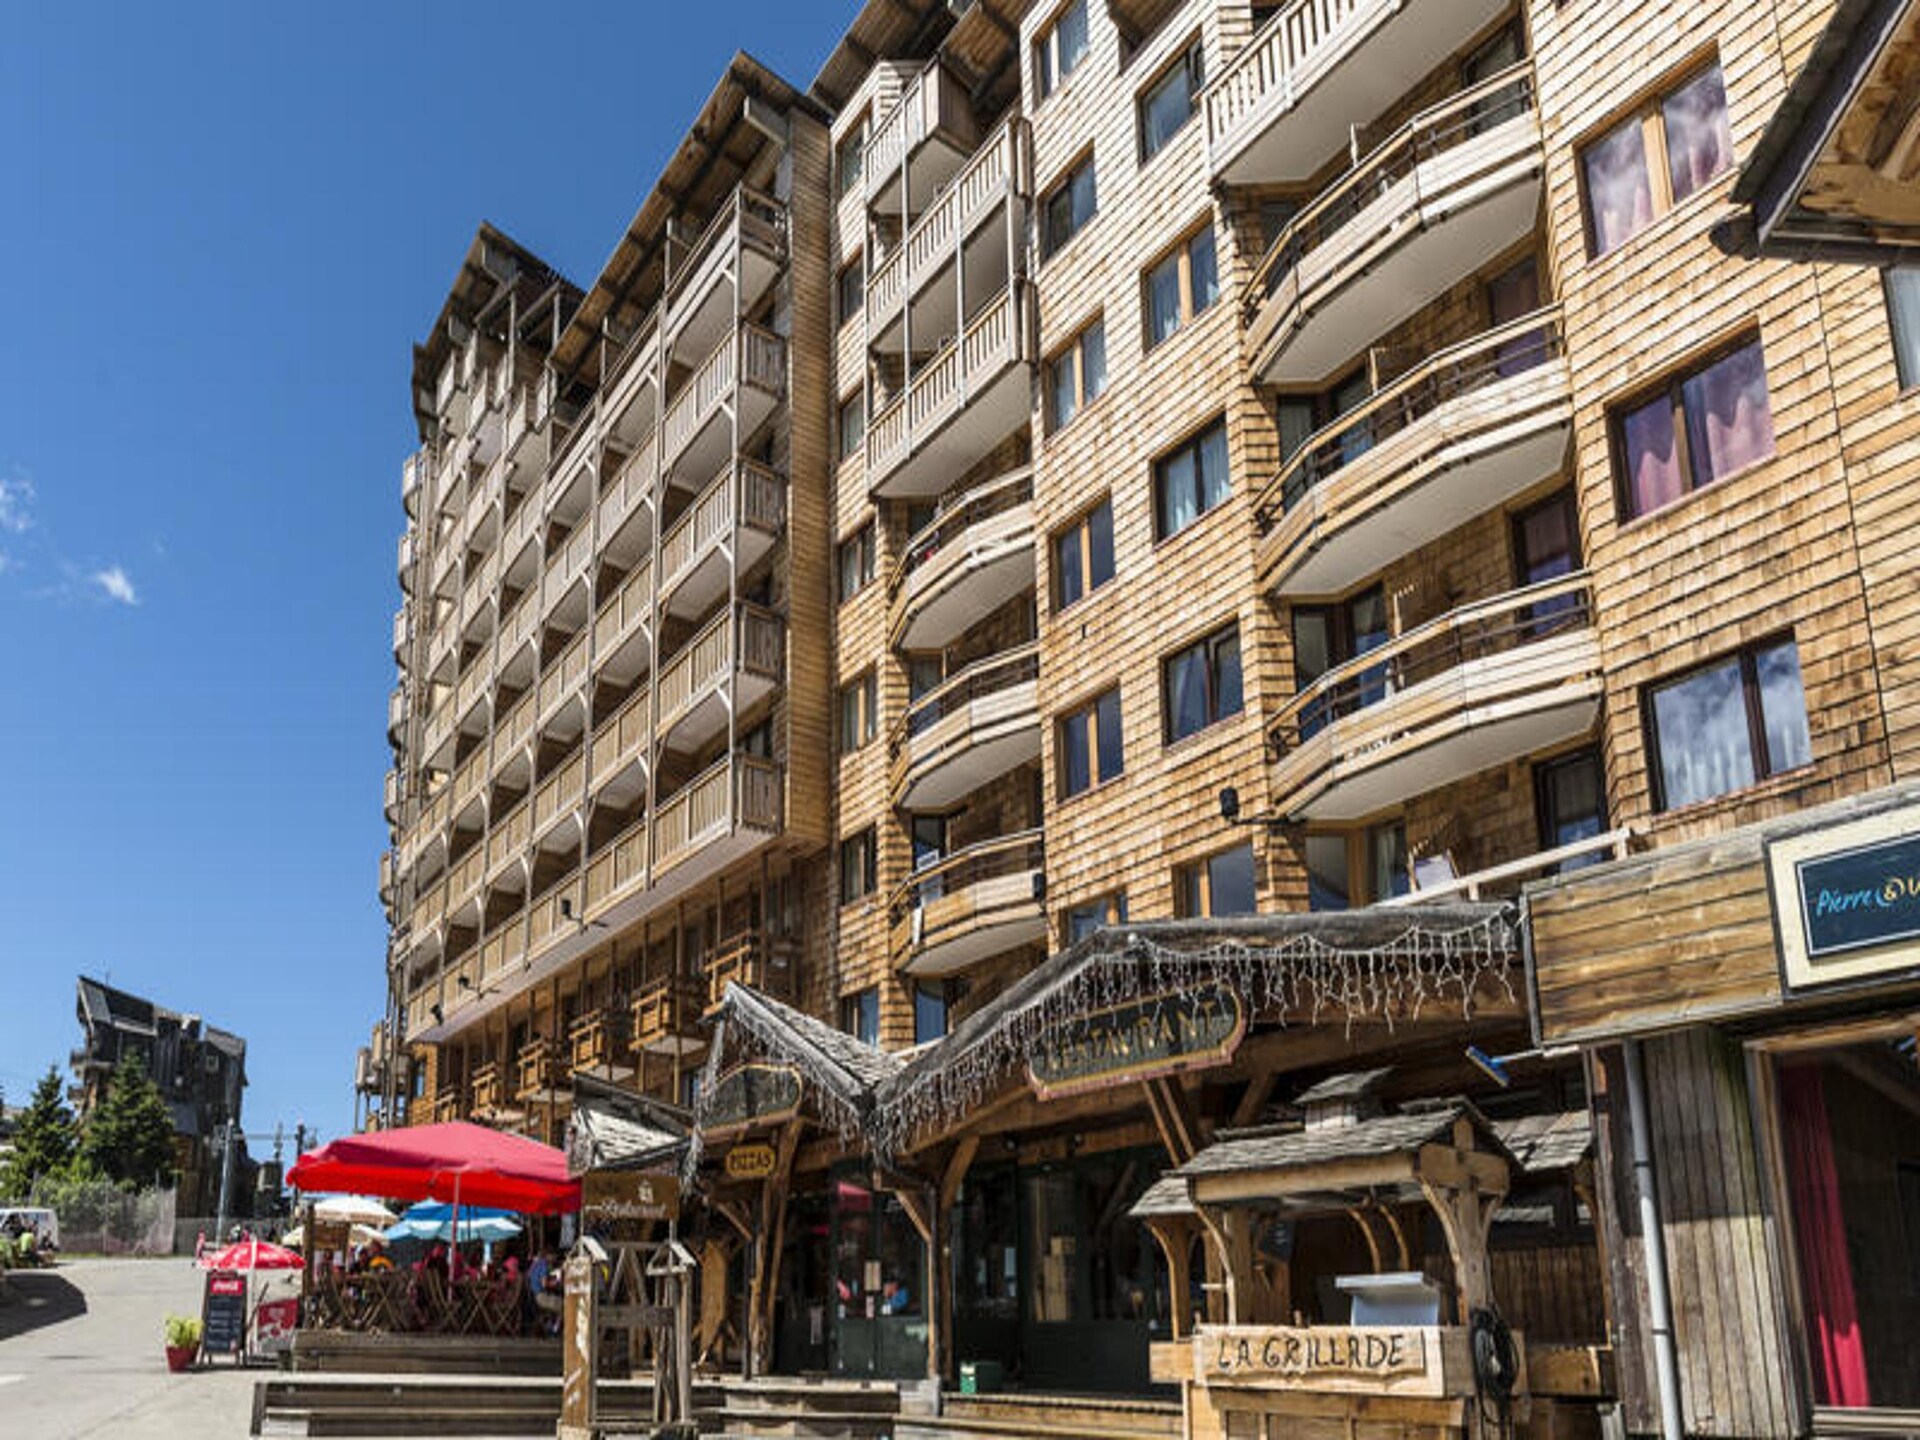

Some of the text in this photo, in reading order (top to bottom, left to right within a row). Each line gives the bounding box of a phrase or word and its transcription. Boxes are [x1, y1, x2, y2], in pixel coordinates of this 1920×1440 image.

[1815, 888, 1874, 917] Pierre
[1218, 1334, 1404, 1369] LA GRILLADE
